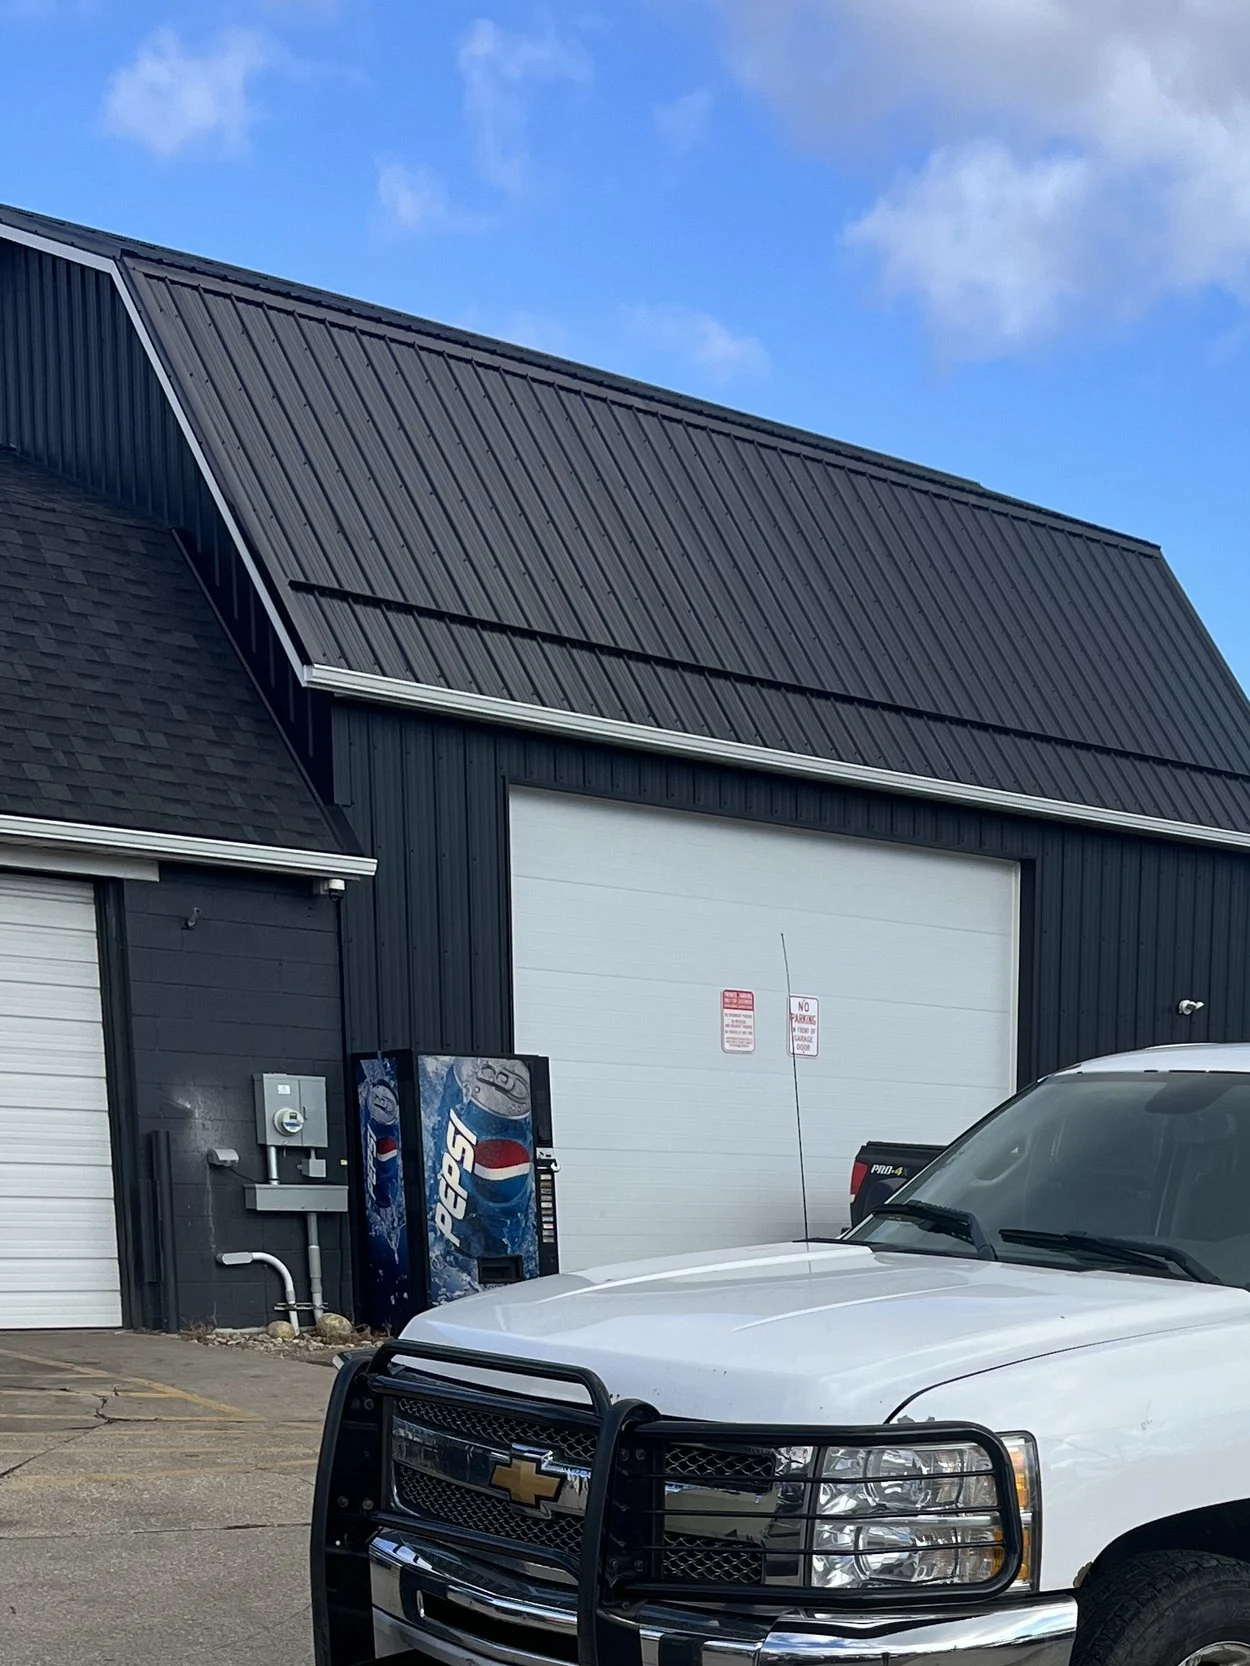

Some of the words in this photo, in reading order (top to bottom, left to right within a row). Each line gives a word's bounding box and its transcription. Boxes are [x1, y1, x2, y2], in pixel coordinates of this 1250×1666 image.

[790, 1013, 817, 1026] PARKING
[798, 1000, 810, 1012] NO
[367, 1123, 377, 1201] PEPSI
[433, 1108, 479, 1248] PEPSI
